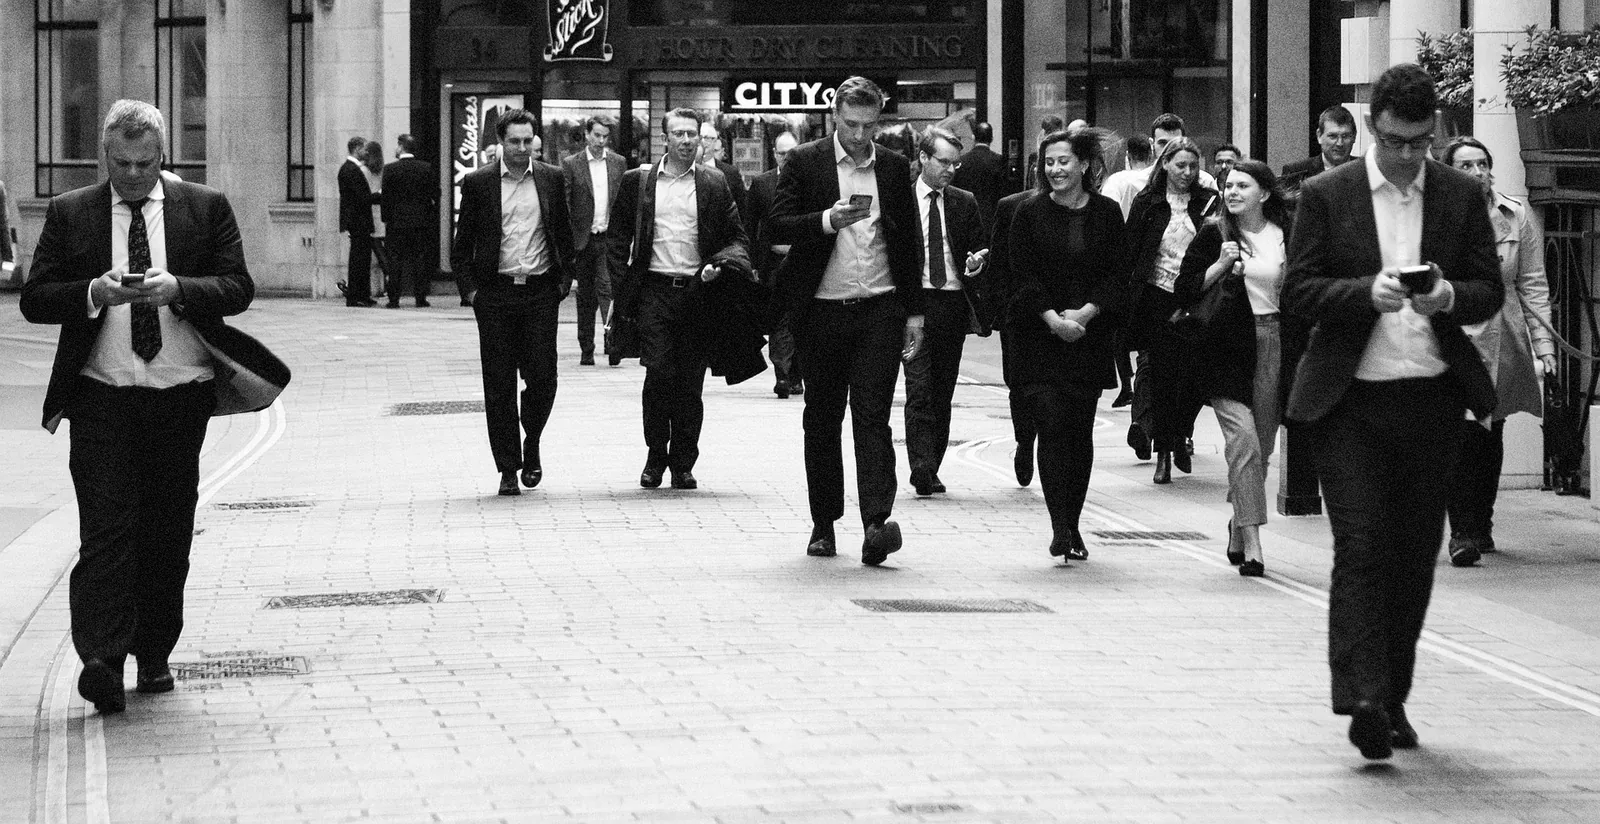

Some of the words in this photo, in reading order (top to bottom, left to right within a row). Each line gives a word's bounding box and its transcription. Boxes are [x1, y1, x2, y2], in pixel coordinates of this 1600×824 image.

[815, 35, 964, 59] CLEANING
[735, 82, 822, 107] CITY
[459, 95, 478, 164] Slickers
